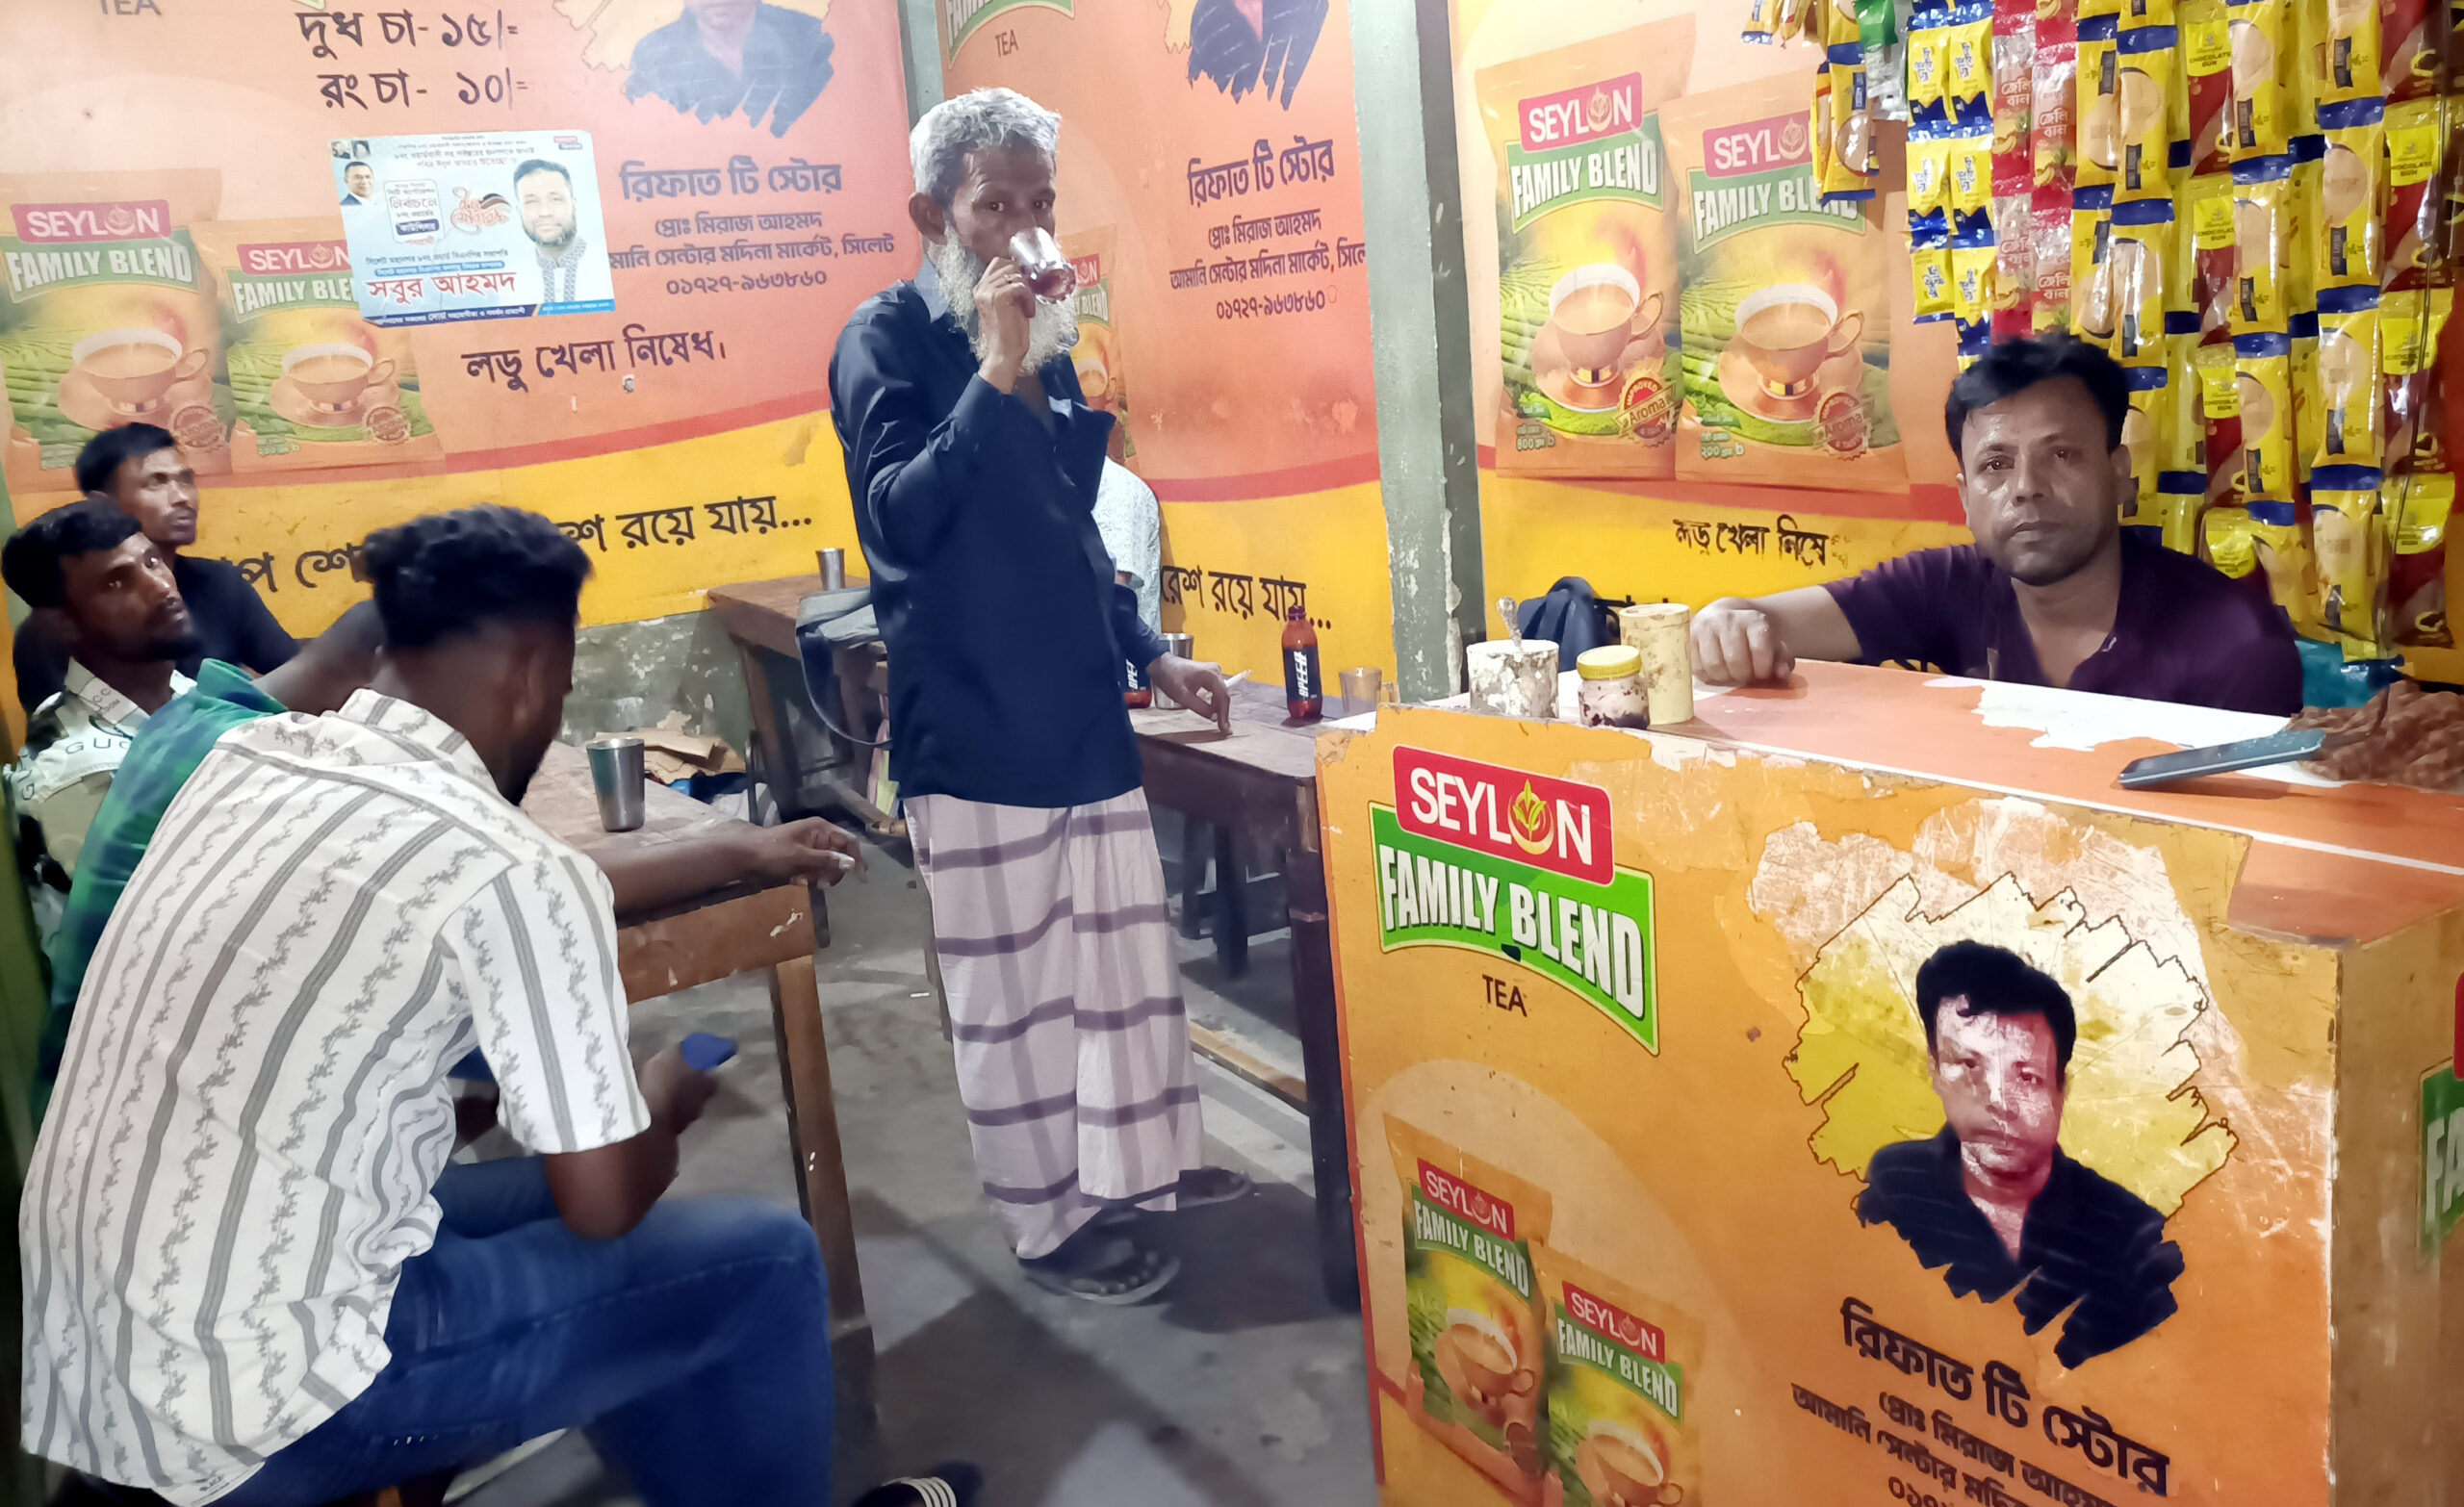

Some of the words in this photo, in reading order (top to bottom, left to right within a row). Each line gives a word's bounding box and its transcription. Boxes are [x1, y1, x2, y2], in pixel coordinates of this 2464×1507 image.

[295, 12, 363, 60] দুধ
[995, 29, 1018, 58] TEA
[317, 73, 368, 110] রং
[1528, 86, 1632, 142] SEYLON
[1714, 117, 1811, 169] SEYLO
[619, 161, 721, 202] রিফাত
[728, 155, 759, 194] টি
[768, 157, 841, 194] স্টোর
[1188, 158, 1248, 208] রিফাত
[1253, 139, 1274, 192] টি
[1280, 136, 1334, 186] স্টোর
[1510, 157, 1582, 219] FAMILY
[1588, 140, 1657, 196] BLEND
[27, 206, 160, 238] SEYLON
[695, 211, 754, 235] মিরাজ
[757, 212, 822, 230] আহমদ
[1233, 215, 1272, 244] মিরাজ
[1274, 209, 1322, 237] আহমদ
[1693, 182, 1771, 241] FAMILY
[6, 251, 100, 292] FAMILY
[109, 245, 192, 283] BLEND
[608, 244, 651, 268] মানি
[654, 243, 716, 266] সেন্টার
[719, 239, 772, 262] মদিনা
[841, 233, 894, 255] সিলেট
[1169, 259, 1207, 290] আমানি
[1249, 249, 1286, 279] মদিনা
[233, 280, 305, 316] FAMILY
[314, 277, 355, 302] BLE
[366, 279, 424, 305] সবুর
[430, 271, 517, 296] আহমদ
[1081, 290, 1109, 322] BLEND
[536, 340, 616, 378] খেলা
[1630, 397, 1666, 424] Aroma
[615, 506, 695, 549] রয়ে
[1208, 571, 1254, 621] রয়ে
[1410, 767, 1593, 866] SEYLON
[1379, 844, 1500, 934] FAMILY
[1509, 882, 1646, 1021] BLEND
[1482, 973, 1528, 1018] TEA
[1425, 1169, 1507, 1235] SEYLON
[1414, 1199, 1469, 1251] FAMILY
[1474, 1234, 1529, 1298] BLEND
[1572, 1292, 1657, 1357] SEYLON
[1557, 1317, 1615, 1369] FAMILY
[1620, 1354, 1678, 1418] BLEND
[1790, 1382, 1871, 1444] আমানি
[1840, 1296, 1973, 1401] রিফাত
[1983, 1360, 2030, 1429] টি
[2043, 1405, 2169, 1498] স্টোর
[1931, 1409, 2015, 1479] মিরাজ
